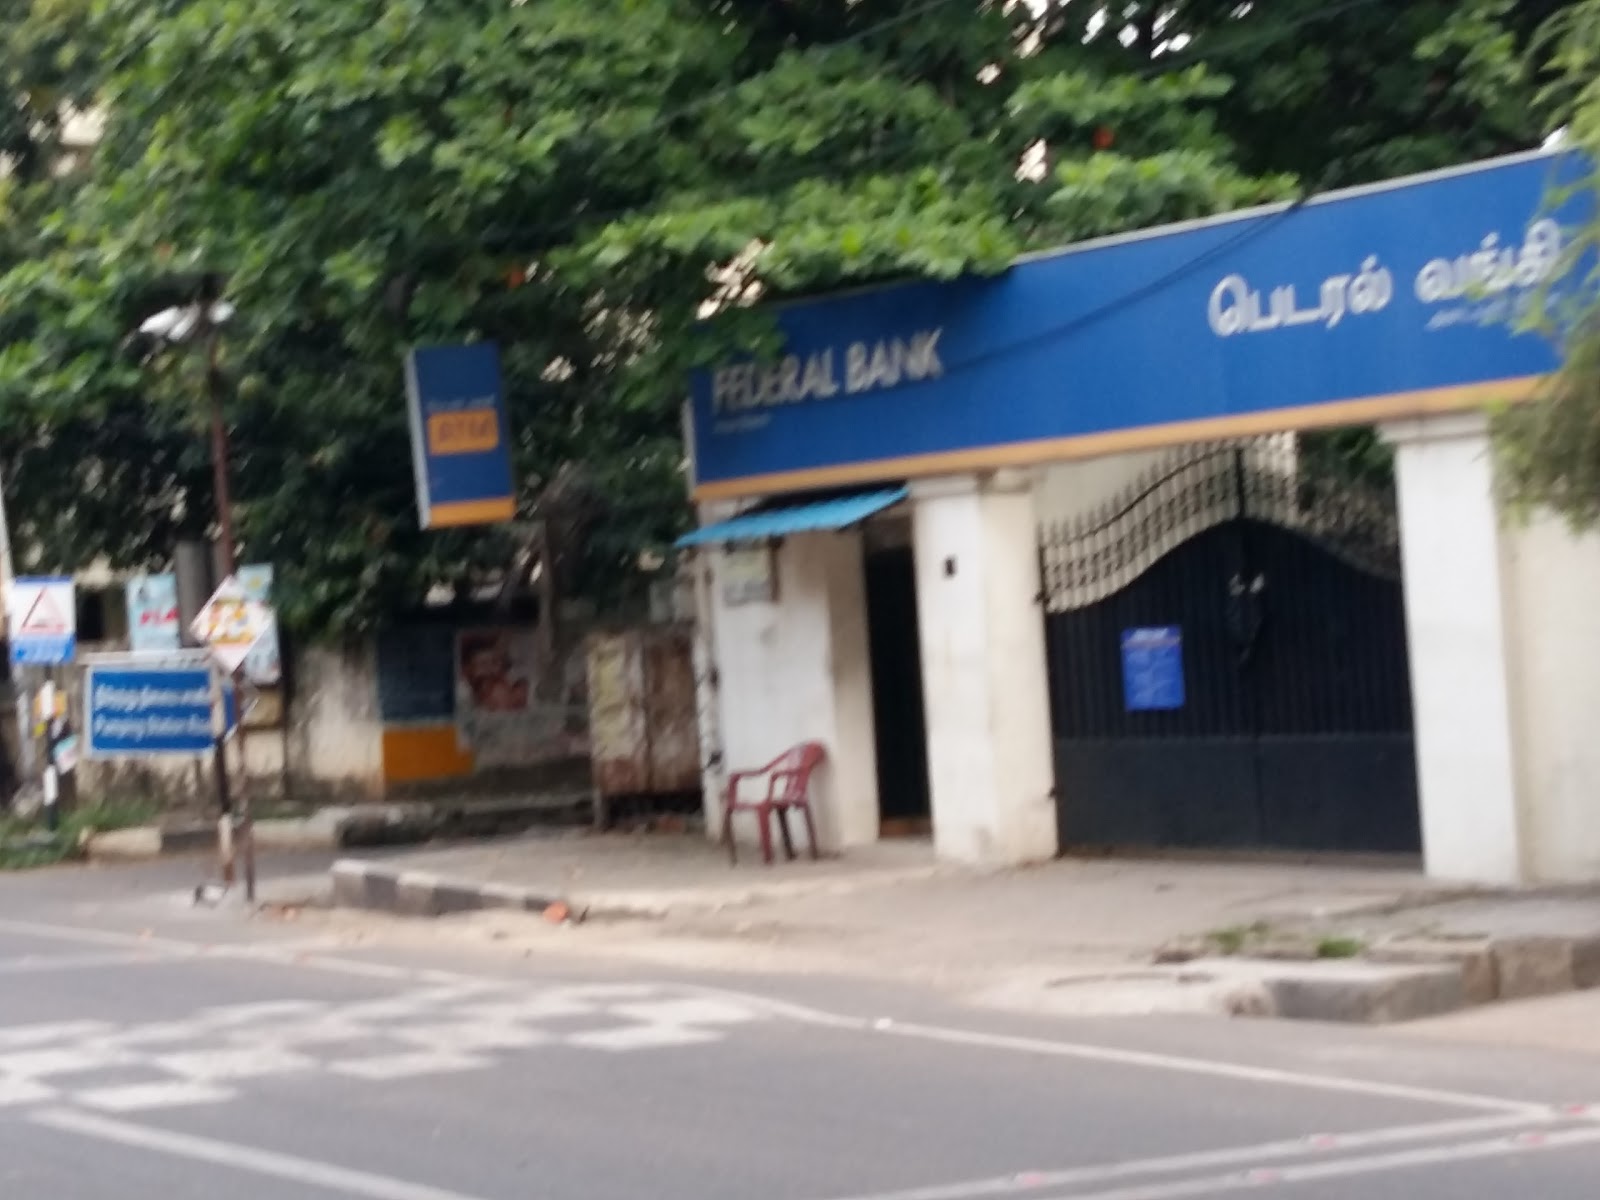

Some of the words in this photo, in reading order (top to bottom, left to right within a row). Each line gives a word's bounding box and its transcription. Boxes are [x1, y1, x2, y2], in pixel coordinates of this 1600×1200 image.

[1208, 254, 1393, 336] பெடரல்
[1414, 218, 1561, 304] வங்கி
[712, 347, 838, 412] FEDERAL
[845, 328, 944, 393] BANK
